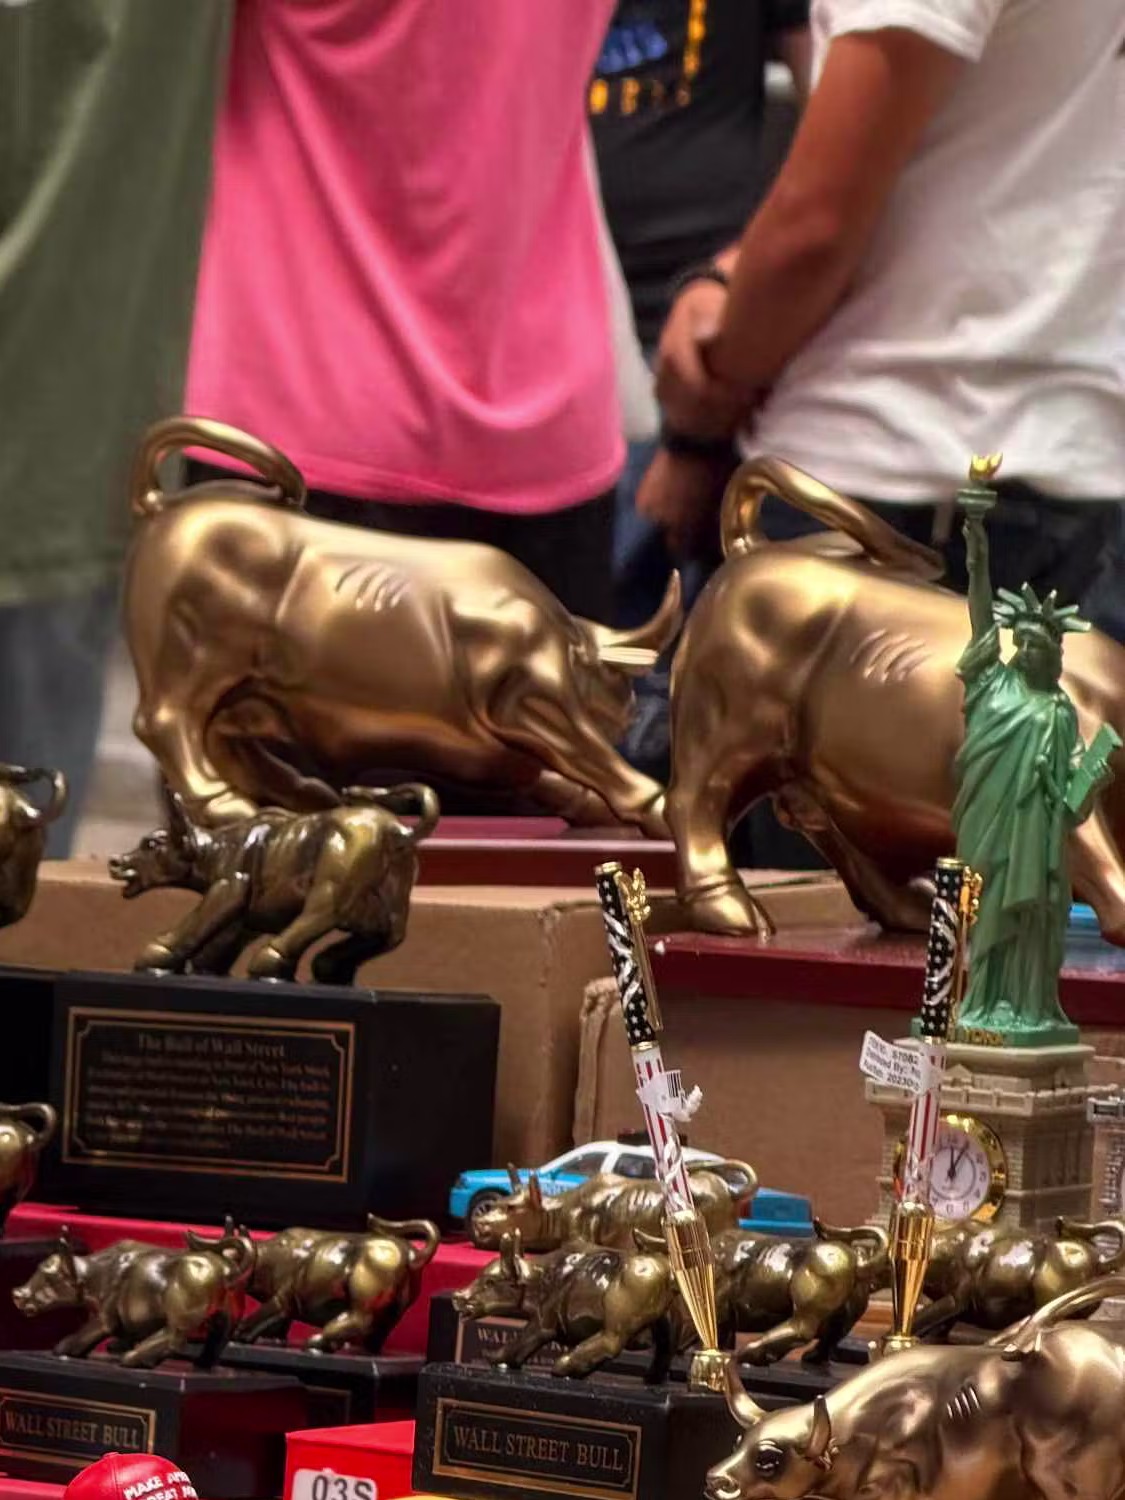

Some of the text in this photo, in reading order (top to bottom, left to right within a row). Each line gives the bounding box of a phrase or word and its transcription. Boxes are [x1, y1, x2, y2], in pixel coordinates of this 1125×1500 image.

[5, 1409, 140, 1449] WALL STREET BULL
[453, 1426, 624, 1472] WALL STREET BULL
[123, 1476, 163, 1500] MAKE
